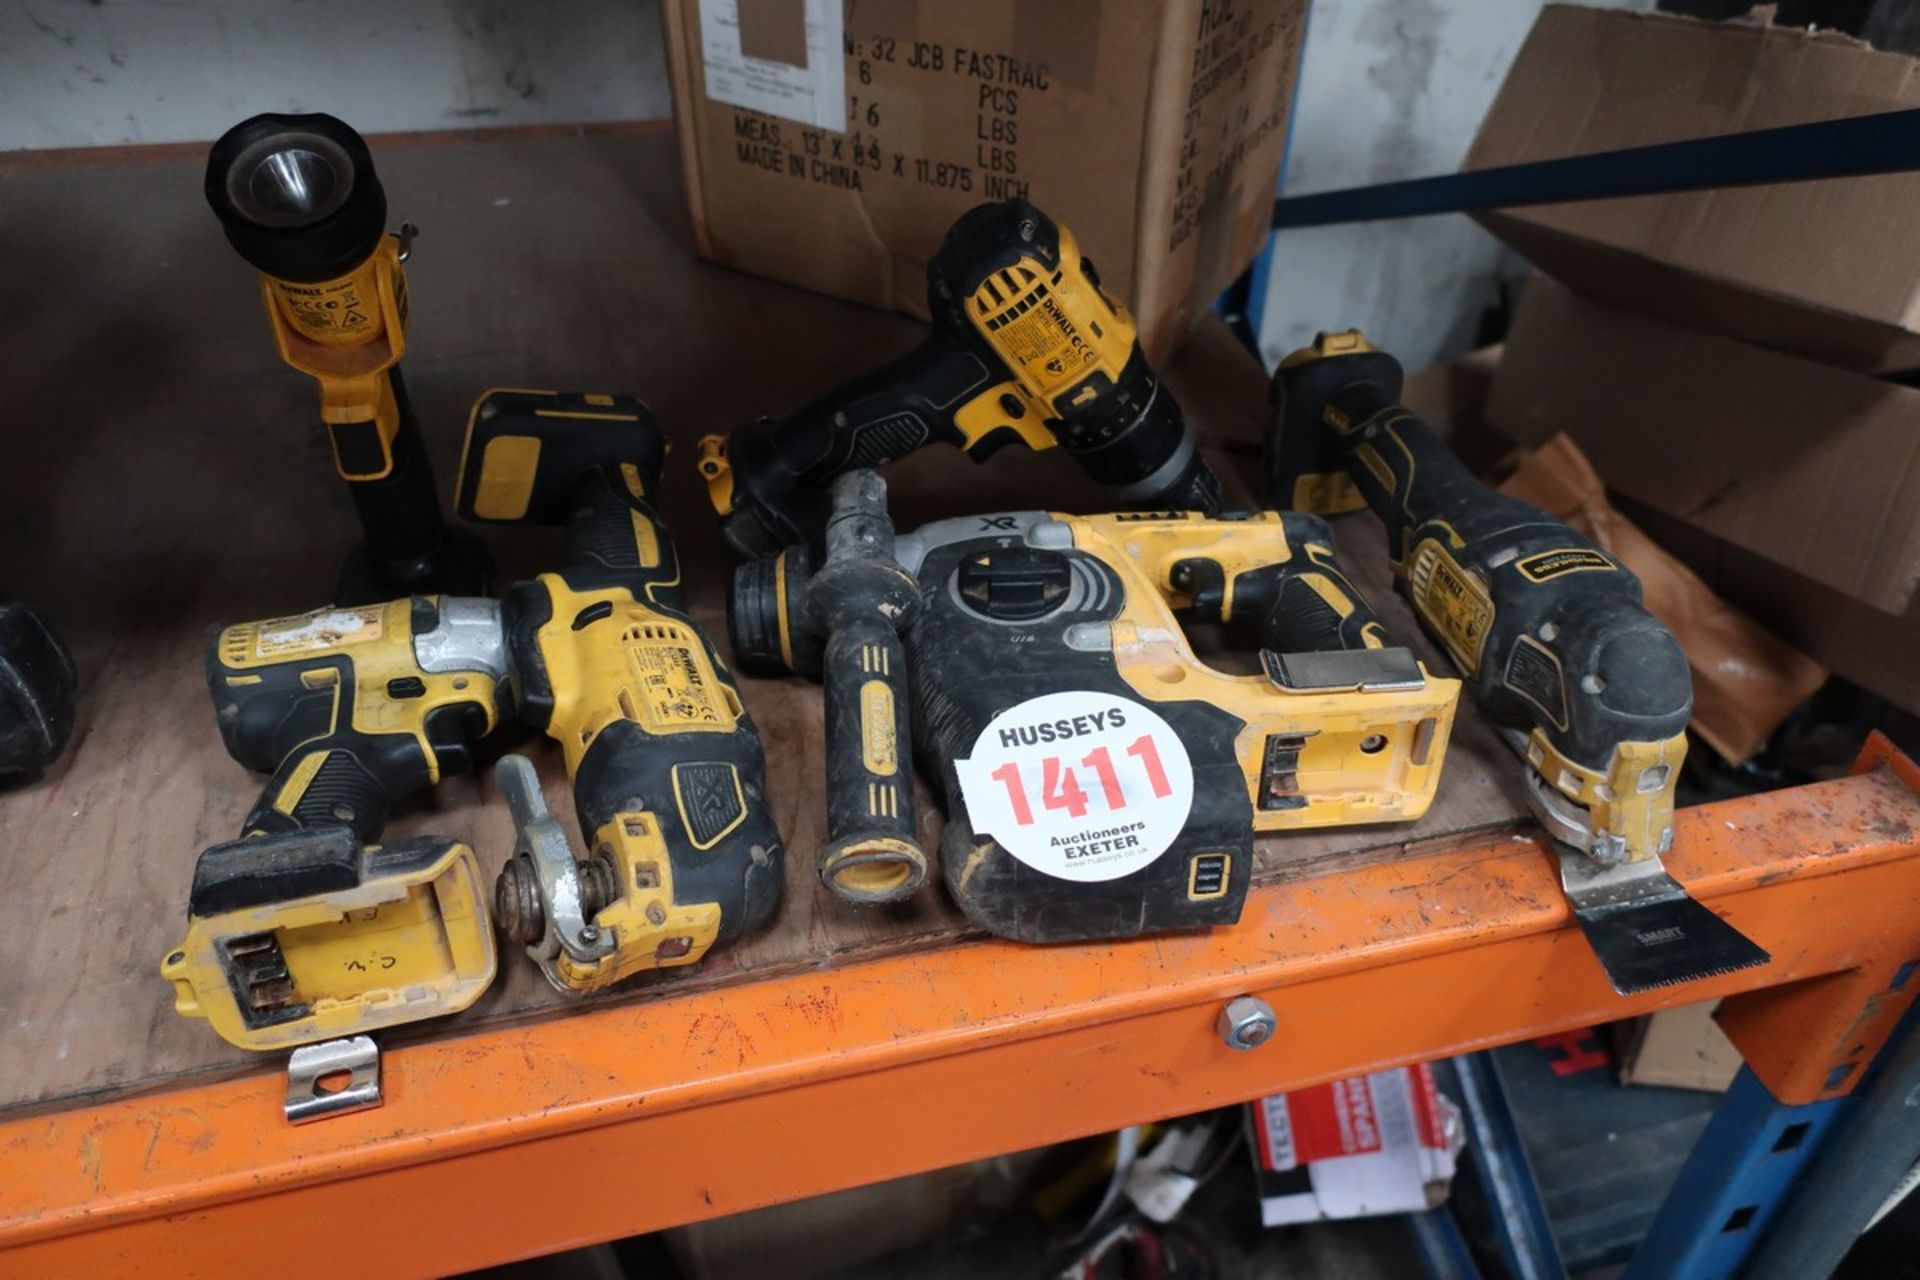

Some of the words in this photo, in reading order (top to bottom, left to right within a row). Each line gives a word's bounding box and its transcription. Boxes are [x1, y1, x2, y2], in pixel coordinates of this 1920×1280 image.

[871, 35, 896, 63] 32
[907, 41, 945, 71] JCB
[953, 48, 1050, 92] FASTRAC
[859, 60, 872, 86] 6
[978, 83, 1019, 116] PCS
[976, 113, 1018, 145] LBS
[736, 140, 785, 174] MADE
[788, 153, 806, 179] IN
[810, 157, 864, 193] CHINA
[915, 157, 974, 193] 11.875
[983, 173, 1030, 201] INCH
[976, 144, 1018, 175] LBS
[999, 707, 1127, 748] HUSSEYS
[991, 734, 1174, 827] 1411
[1050, 820, 1146, 848] Auctioneers
[1064, 834, 1140, 861] EXETER
[1264, 1094, 1290, 1163] TECT
